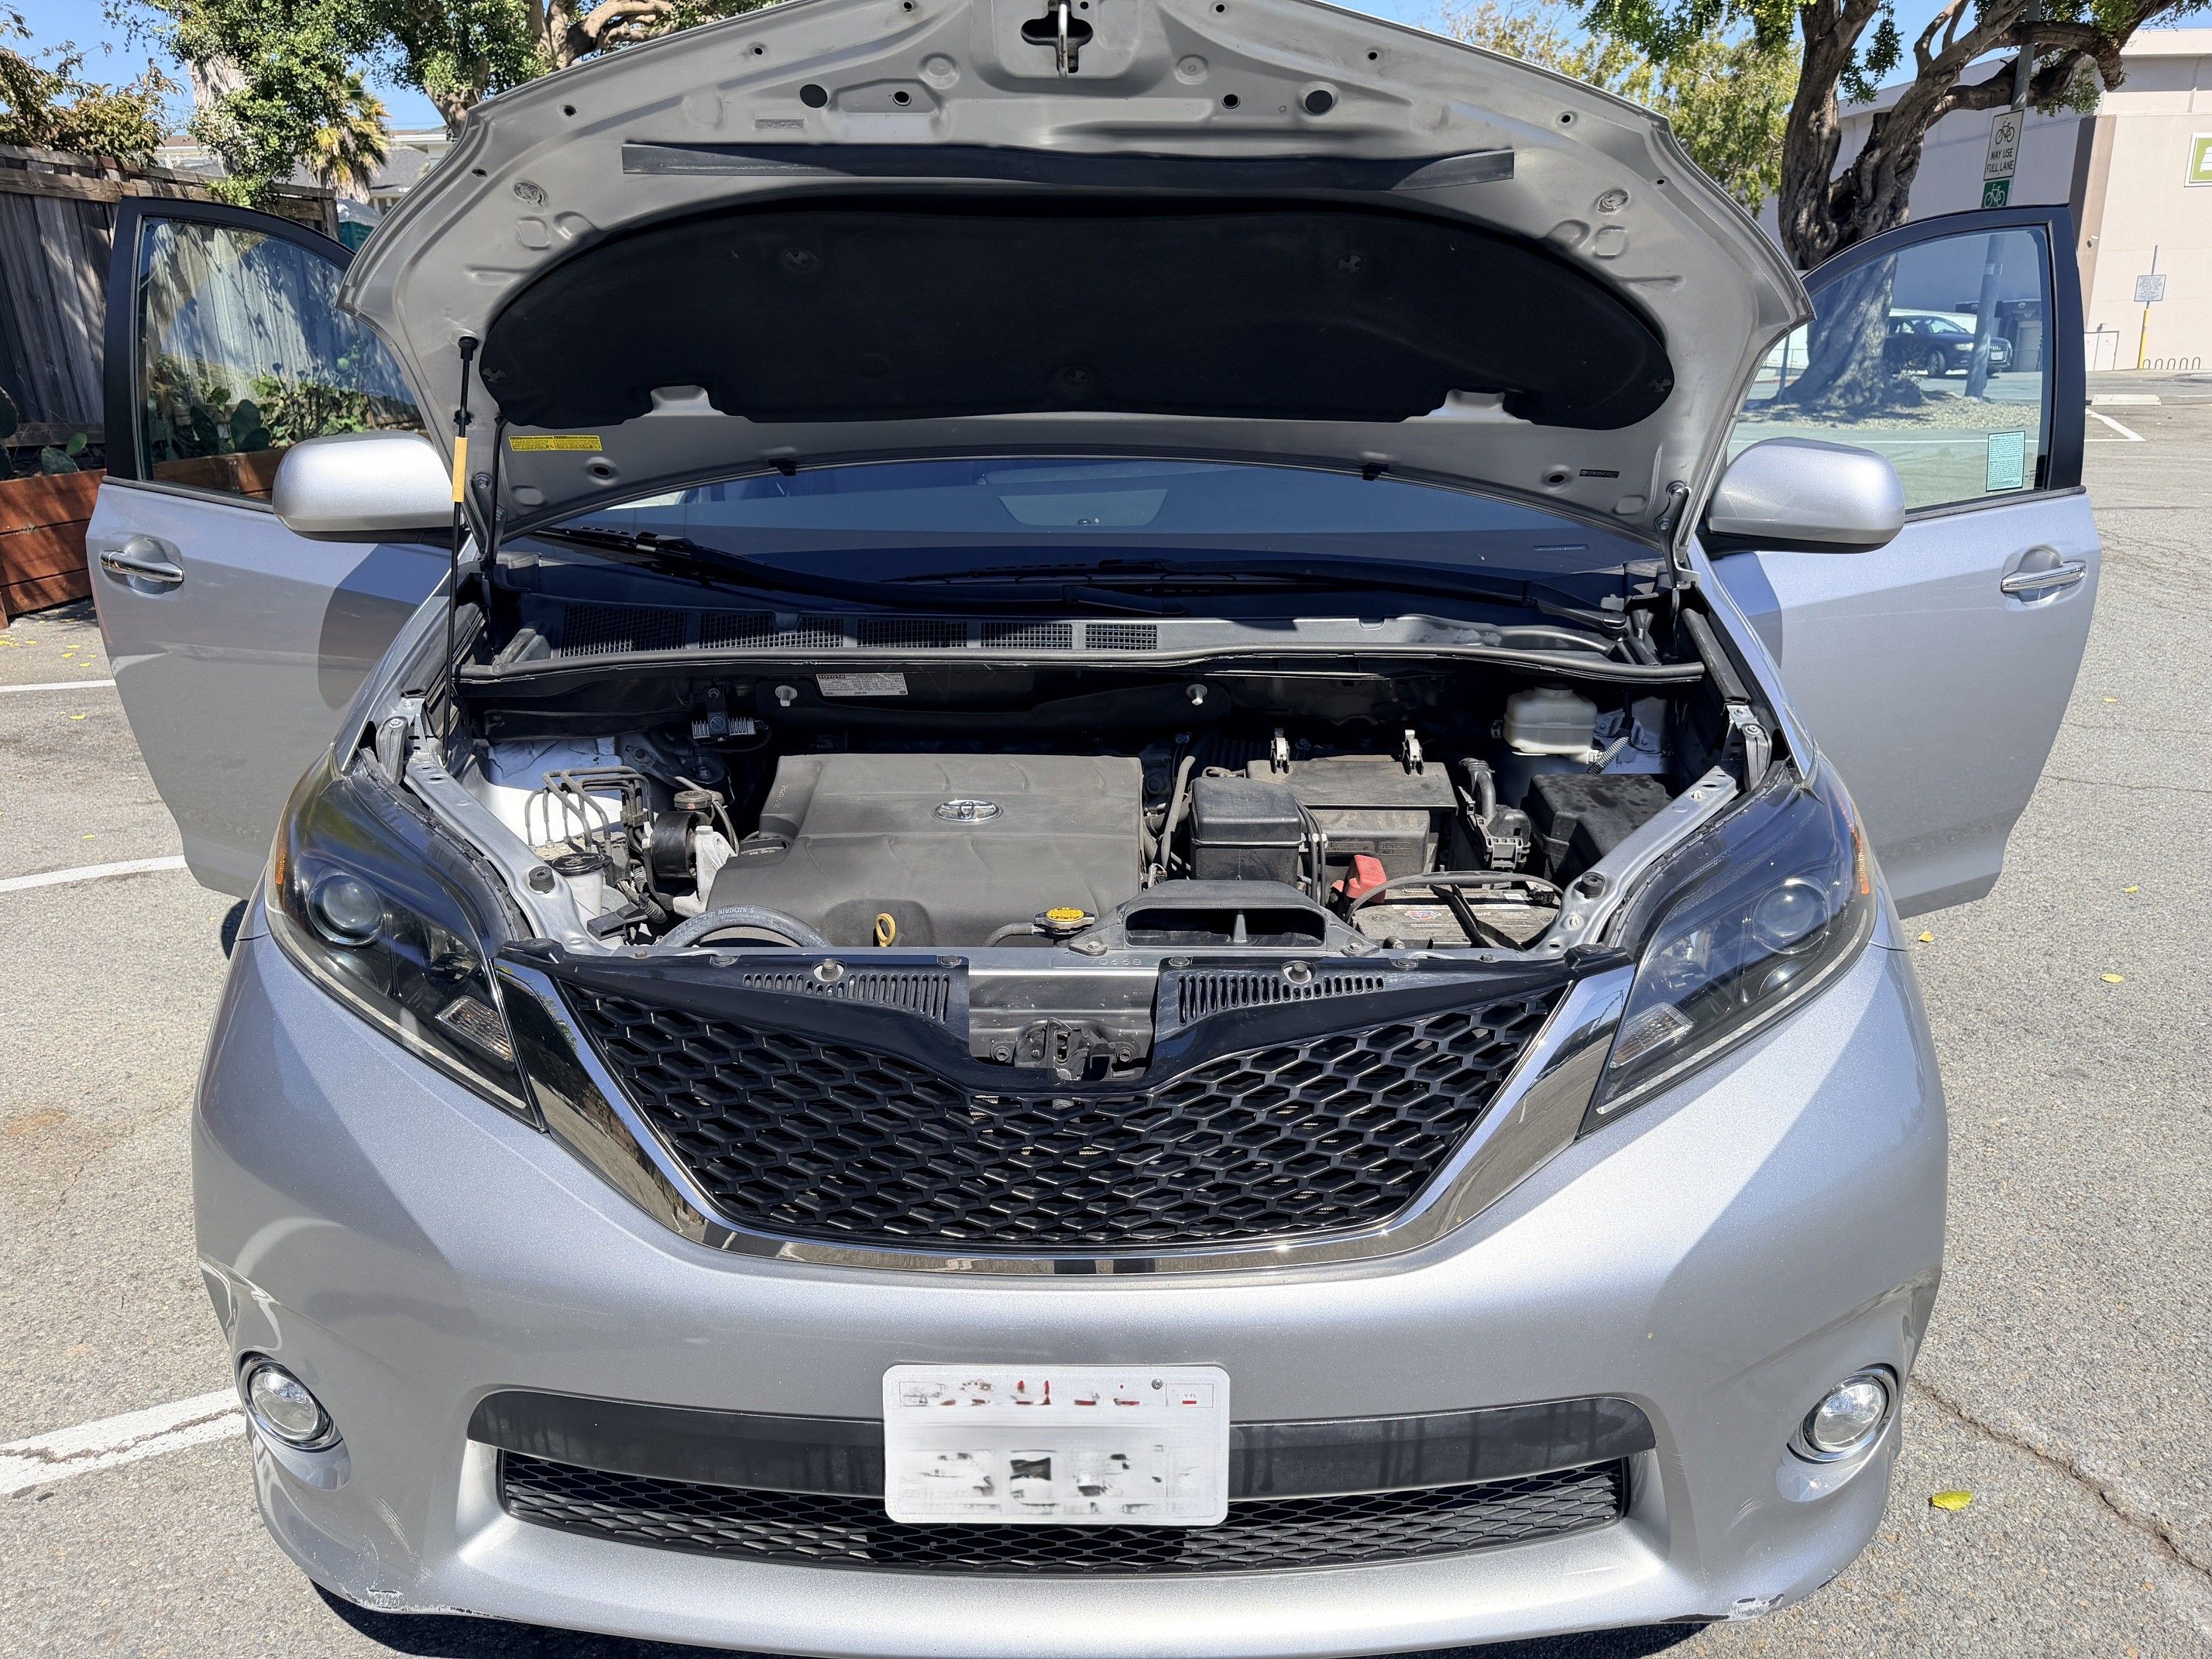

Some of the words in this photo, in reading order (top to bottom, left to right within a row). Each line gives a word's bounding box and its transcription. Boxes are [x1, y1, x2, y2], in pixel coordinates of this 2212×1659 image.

[1991, 149, 2001, 160] MAY
[2003, 147, 2014, 159] USE
[1987, 163, 1998, 173] FULL
[1999, 160, 2014, 172] LANE
